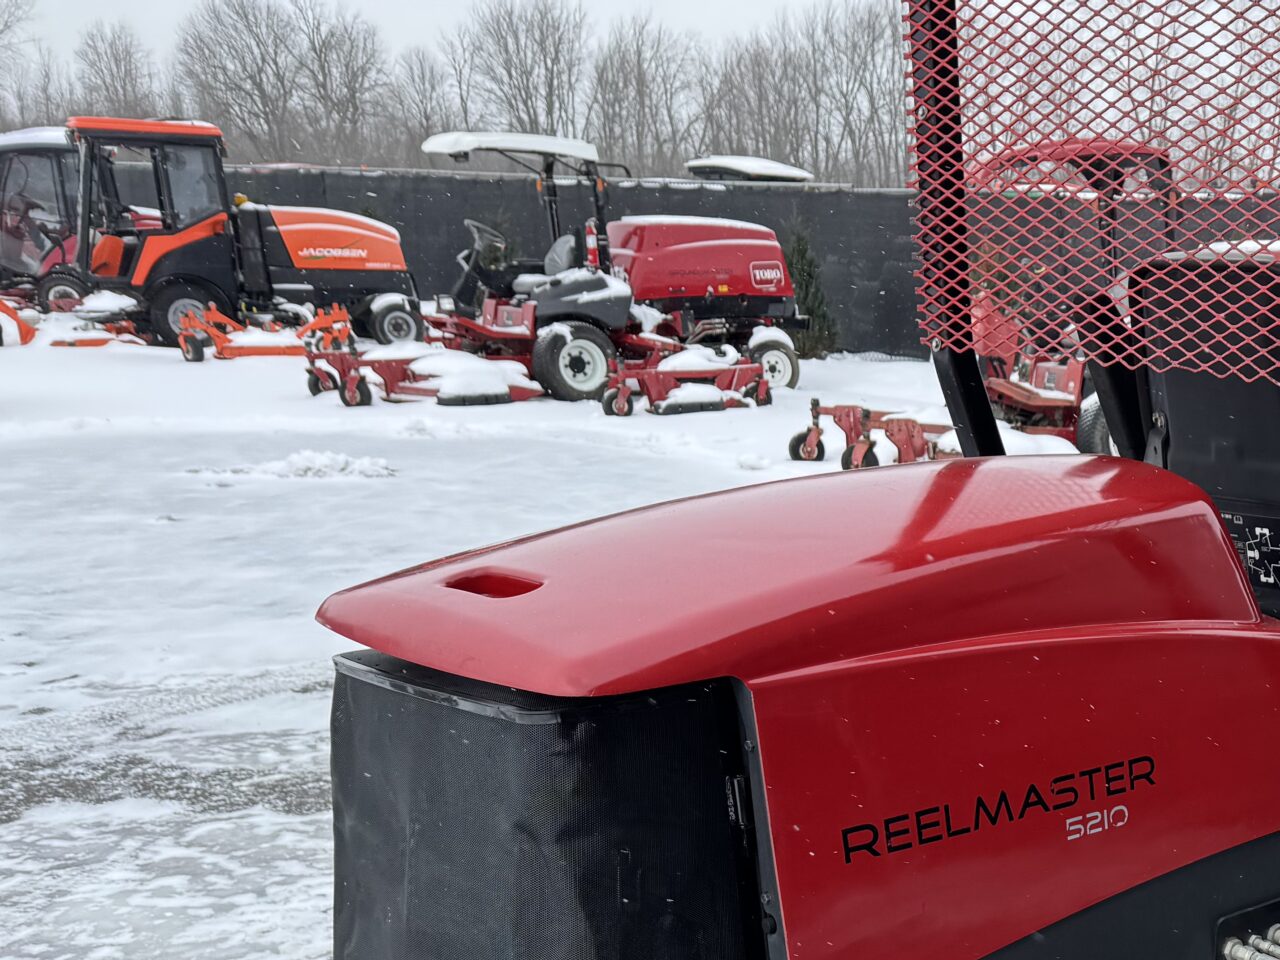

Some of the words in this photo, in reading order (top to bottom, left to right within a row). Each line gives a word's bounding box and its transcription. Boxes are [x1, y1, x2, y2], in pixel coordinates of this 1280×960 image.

[298, 248, 367, 258] JACOBSEN
[754, 269, 780, 281] TORO
[841, 755, 1156, 864] REELMASTER
[1065, 805, 1129, 840] 5210
